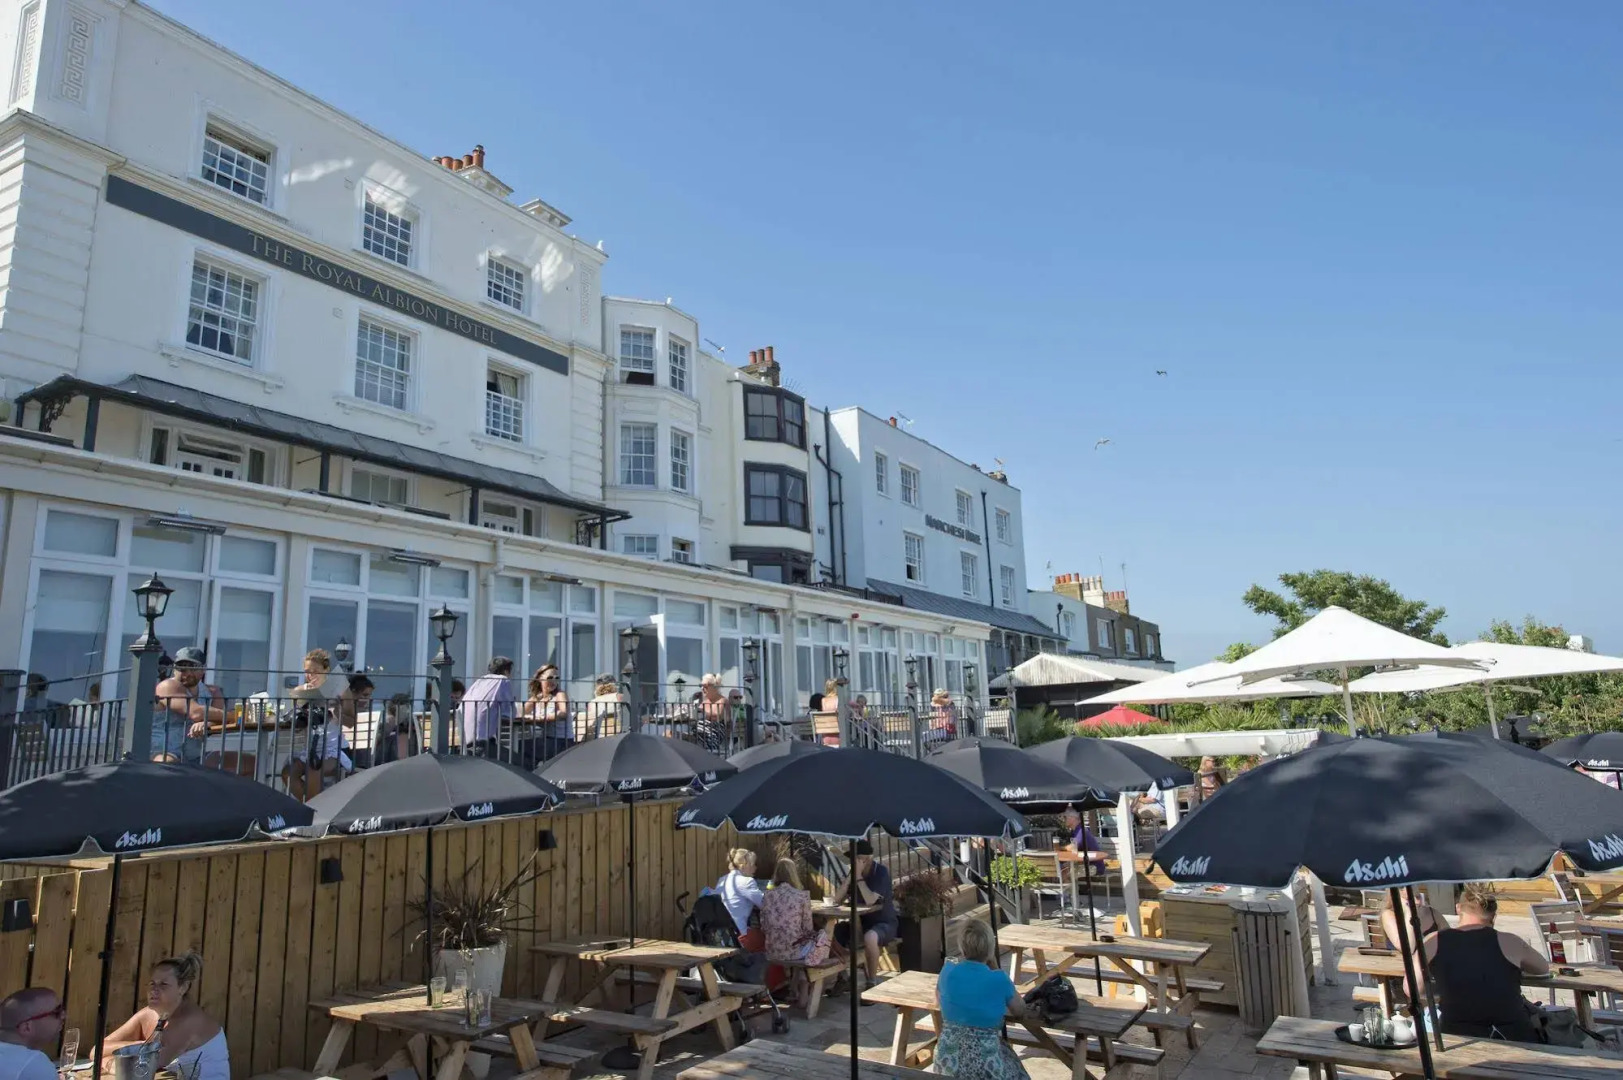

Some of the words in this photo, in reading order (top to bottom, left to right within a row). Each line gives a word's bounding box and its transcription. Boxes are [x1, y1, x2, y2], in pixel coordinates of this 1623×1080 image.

[248, 232, 293, 266] THE
[302, 253, 366, 294] ROYAL
[372, 284, 438, 322] ALBION
[445, 310, 497, 345] HOTEL
[618, 777, 642, 791] Asahi
[1000, 786, 1029, 799] Asahi
[468, 802, 493, 818] Asahi
[350, 815, 383, 833] Asahi
[746, 814, 789, 829] Asahi
[899, 817, 935, 834] Asahi
[115, 827, 161, 848] Asahi
[1170, 855, 1211, 876] Asahi
[1344, 854, 1410, 883] Asahi
